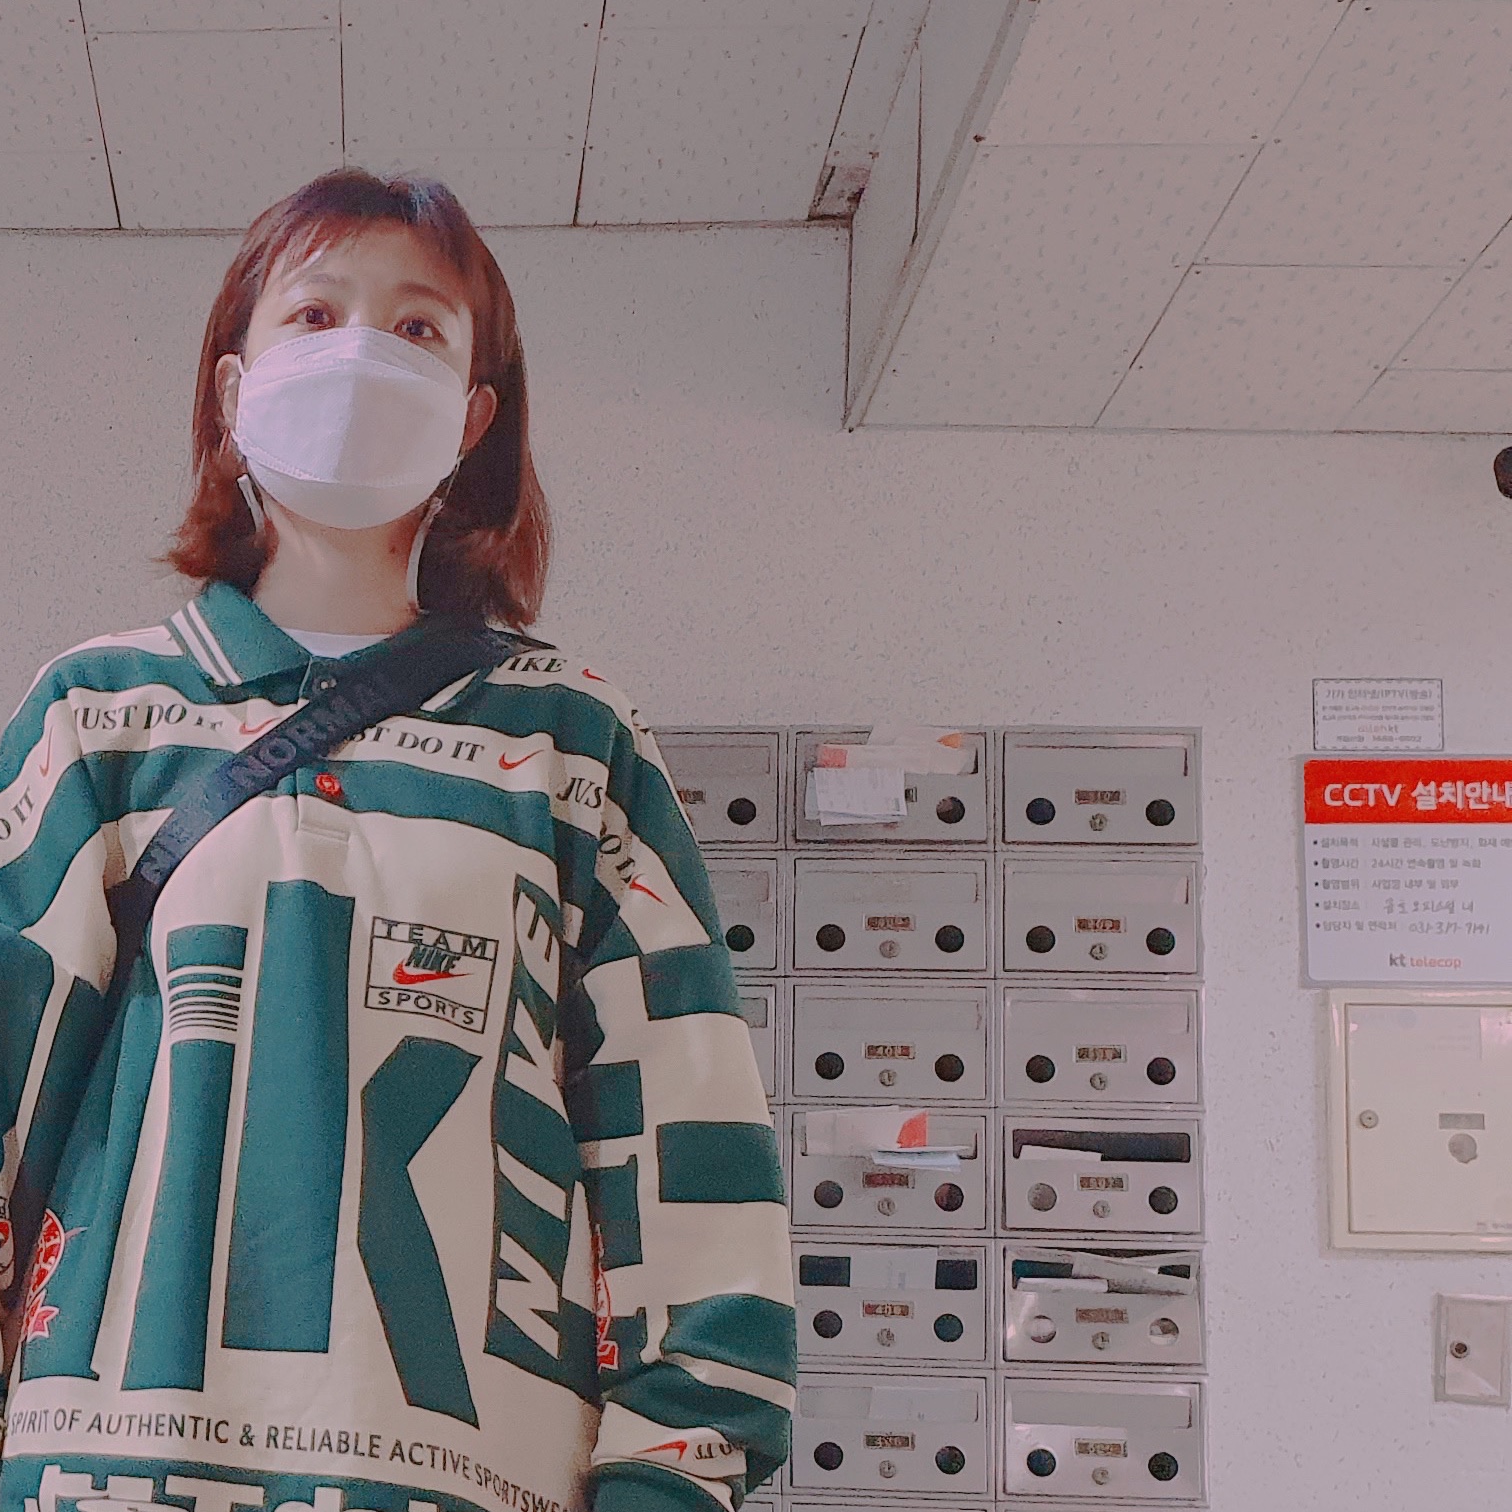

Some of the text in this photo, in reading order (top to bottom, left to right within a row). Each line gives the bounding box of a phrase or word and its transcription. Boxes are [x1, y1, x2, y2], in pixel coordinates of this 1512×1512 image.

[498, 655, 567, 673] IKE
[143, 703, 187, 730] DO
[395, 731, 443, 755] DO
[450, 740, 485, 762] IT
[11, 784, 35, 826] IT
[1324, 784, 1402, 807] CCTV
[381, 920, 488, 958] TEAM
[404, 940, 462, 974] NIKE
[1389, 953, 1461, 970] kt telecop
[377, 989, 475, 1025] SPORTS
[10, 1409, 50, 1436] SPIRIT
[53, 1408, 83, 1431] OF
[87, 1411, 230, 1444] AUTHENTIC
[239, 1423, 255, 1448] &
[265, 1424, 383, 1459] RELIABLE
[389, 1438, 471, 1481] ACTIVE
